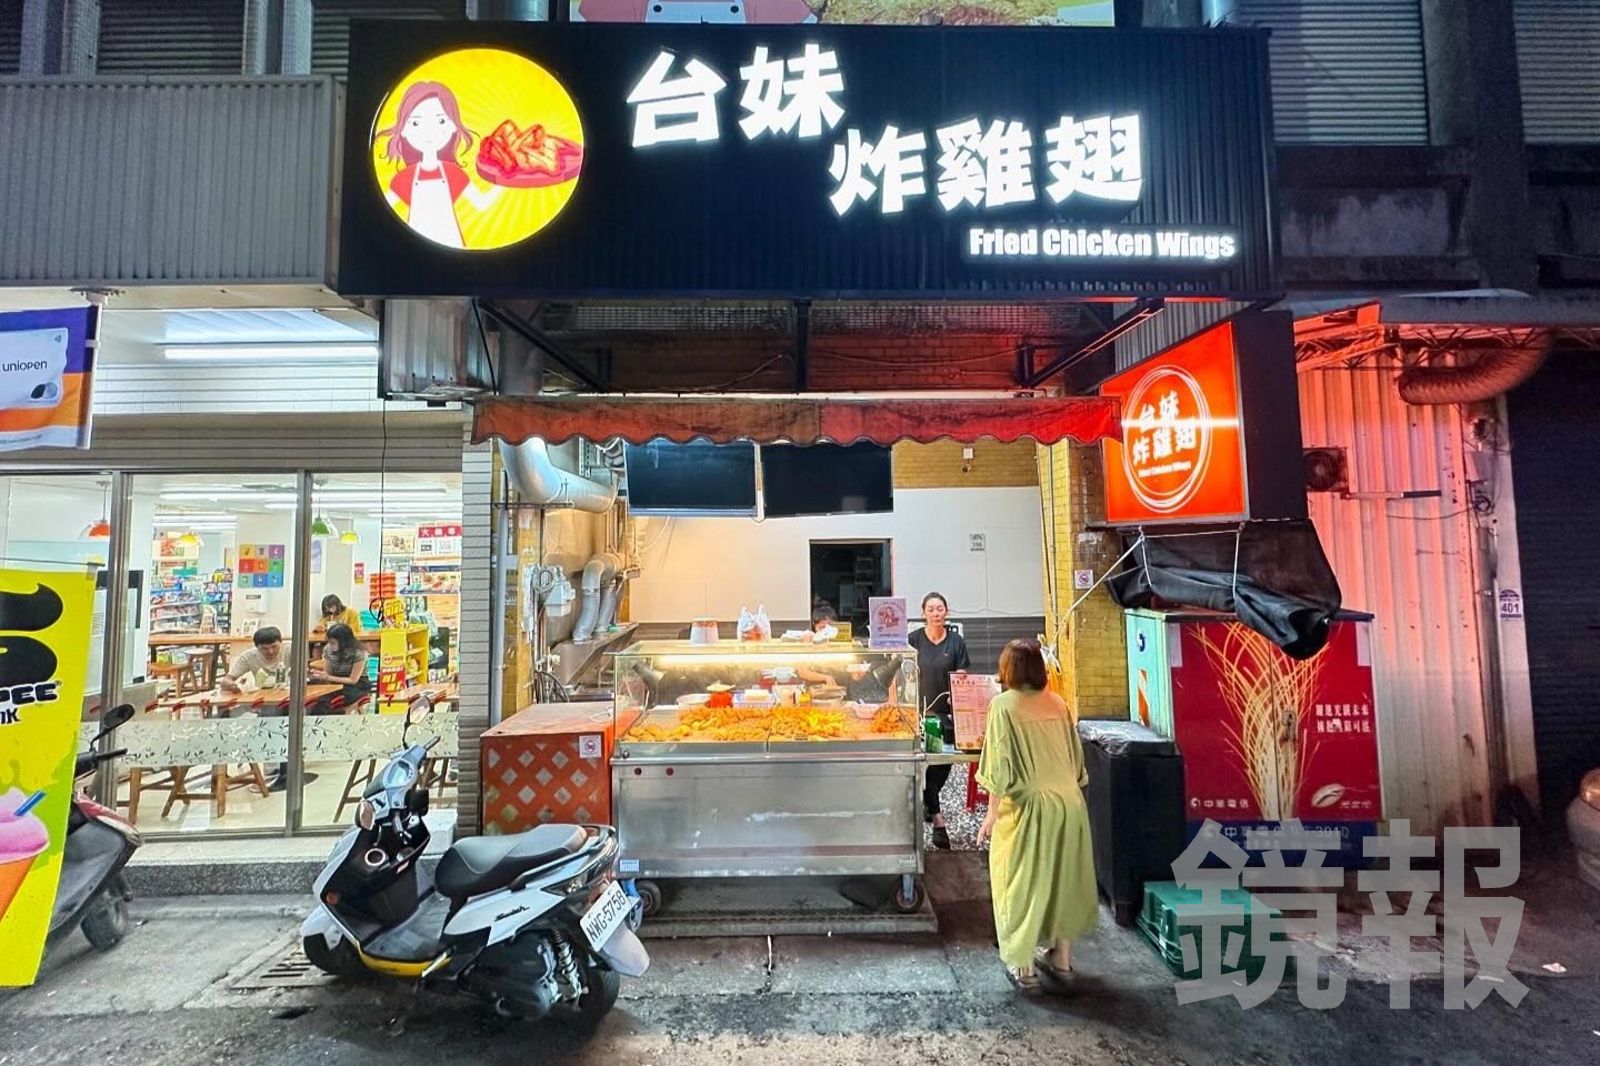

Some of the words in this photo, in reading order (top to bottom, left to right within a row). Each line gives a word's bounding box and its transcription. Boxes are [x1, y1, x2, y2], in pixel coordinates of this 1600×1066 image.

[627, 43, 845, 149] 台妹
[829, 111, 1143, 216] 炸雞翅
[969, 228, 1037, 256] Fried
[1042, 228, 1153, 257] Chicken
[1156, 231, 1235, 260] Wings
[1138, 390, 1180, 433] 台妹
[1501, 602, 1519, 613] 401
